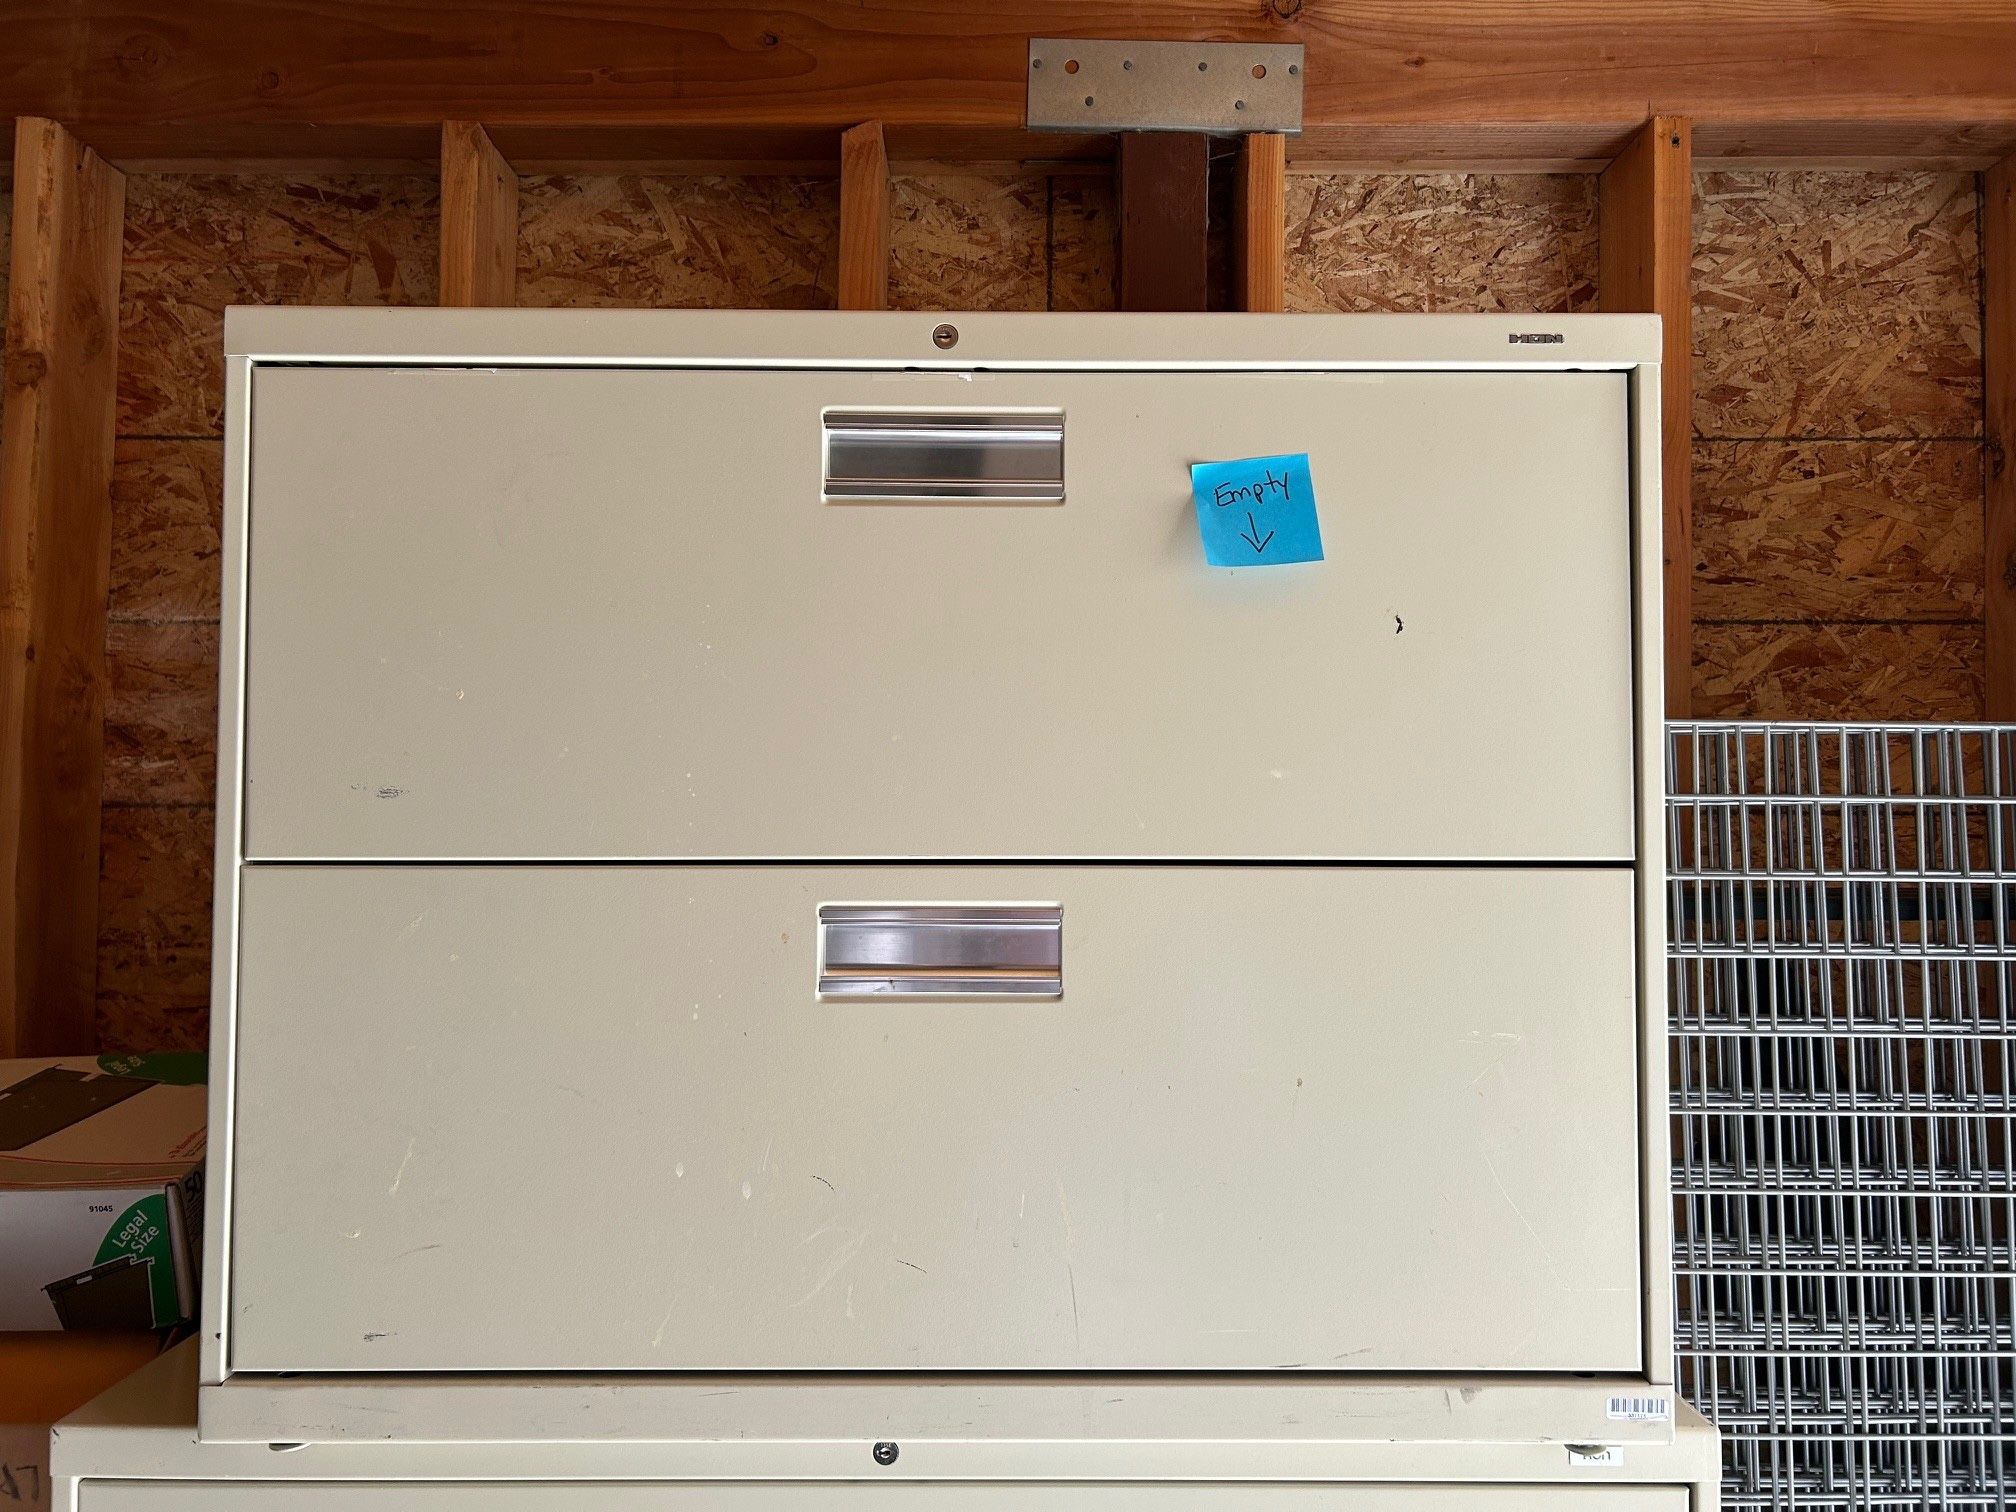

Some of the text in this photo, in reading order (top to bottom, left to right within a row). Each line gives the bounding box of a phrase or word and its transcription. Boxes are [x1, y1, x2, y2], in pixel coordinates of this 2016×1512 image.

[1214, 470, 1290, 507] Empty
[89, 1205, 113, 1213] 91045
[112, 1209, 148, 1248] Legal
[130, 1224, 160, 1253] Size
